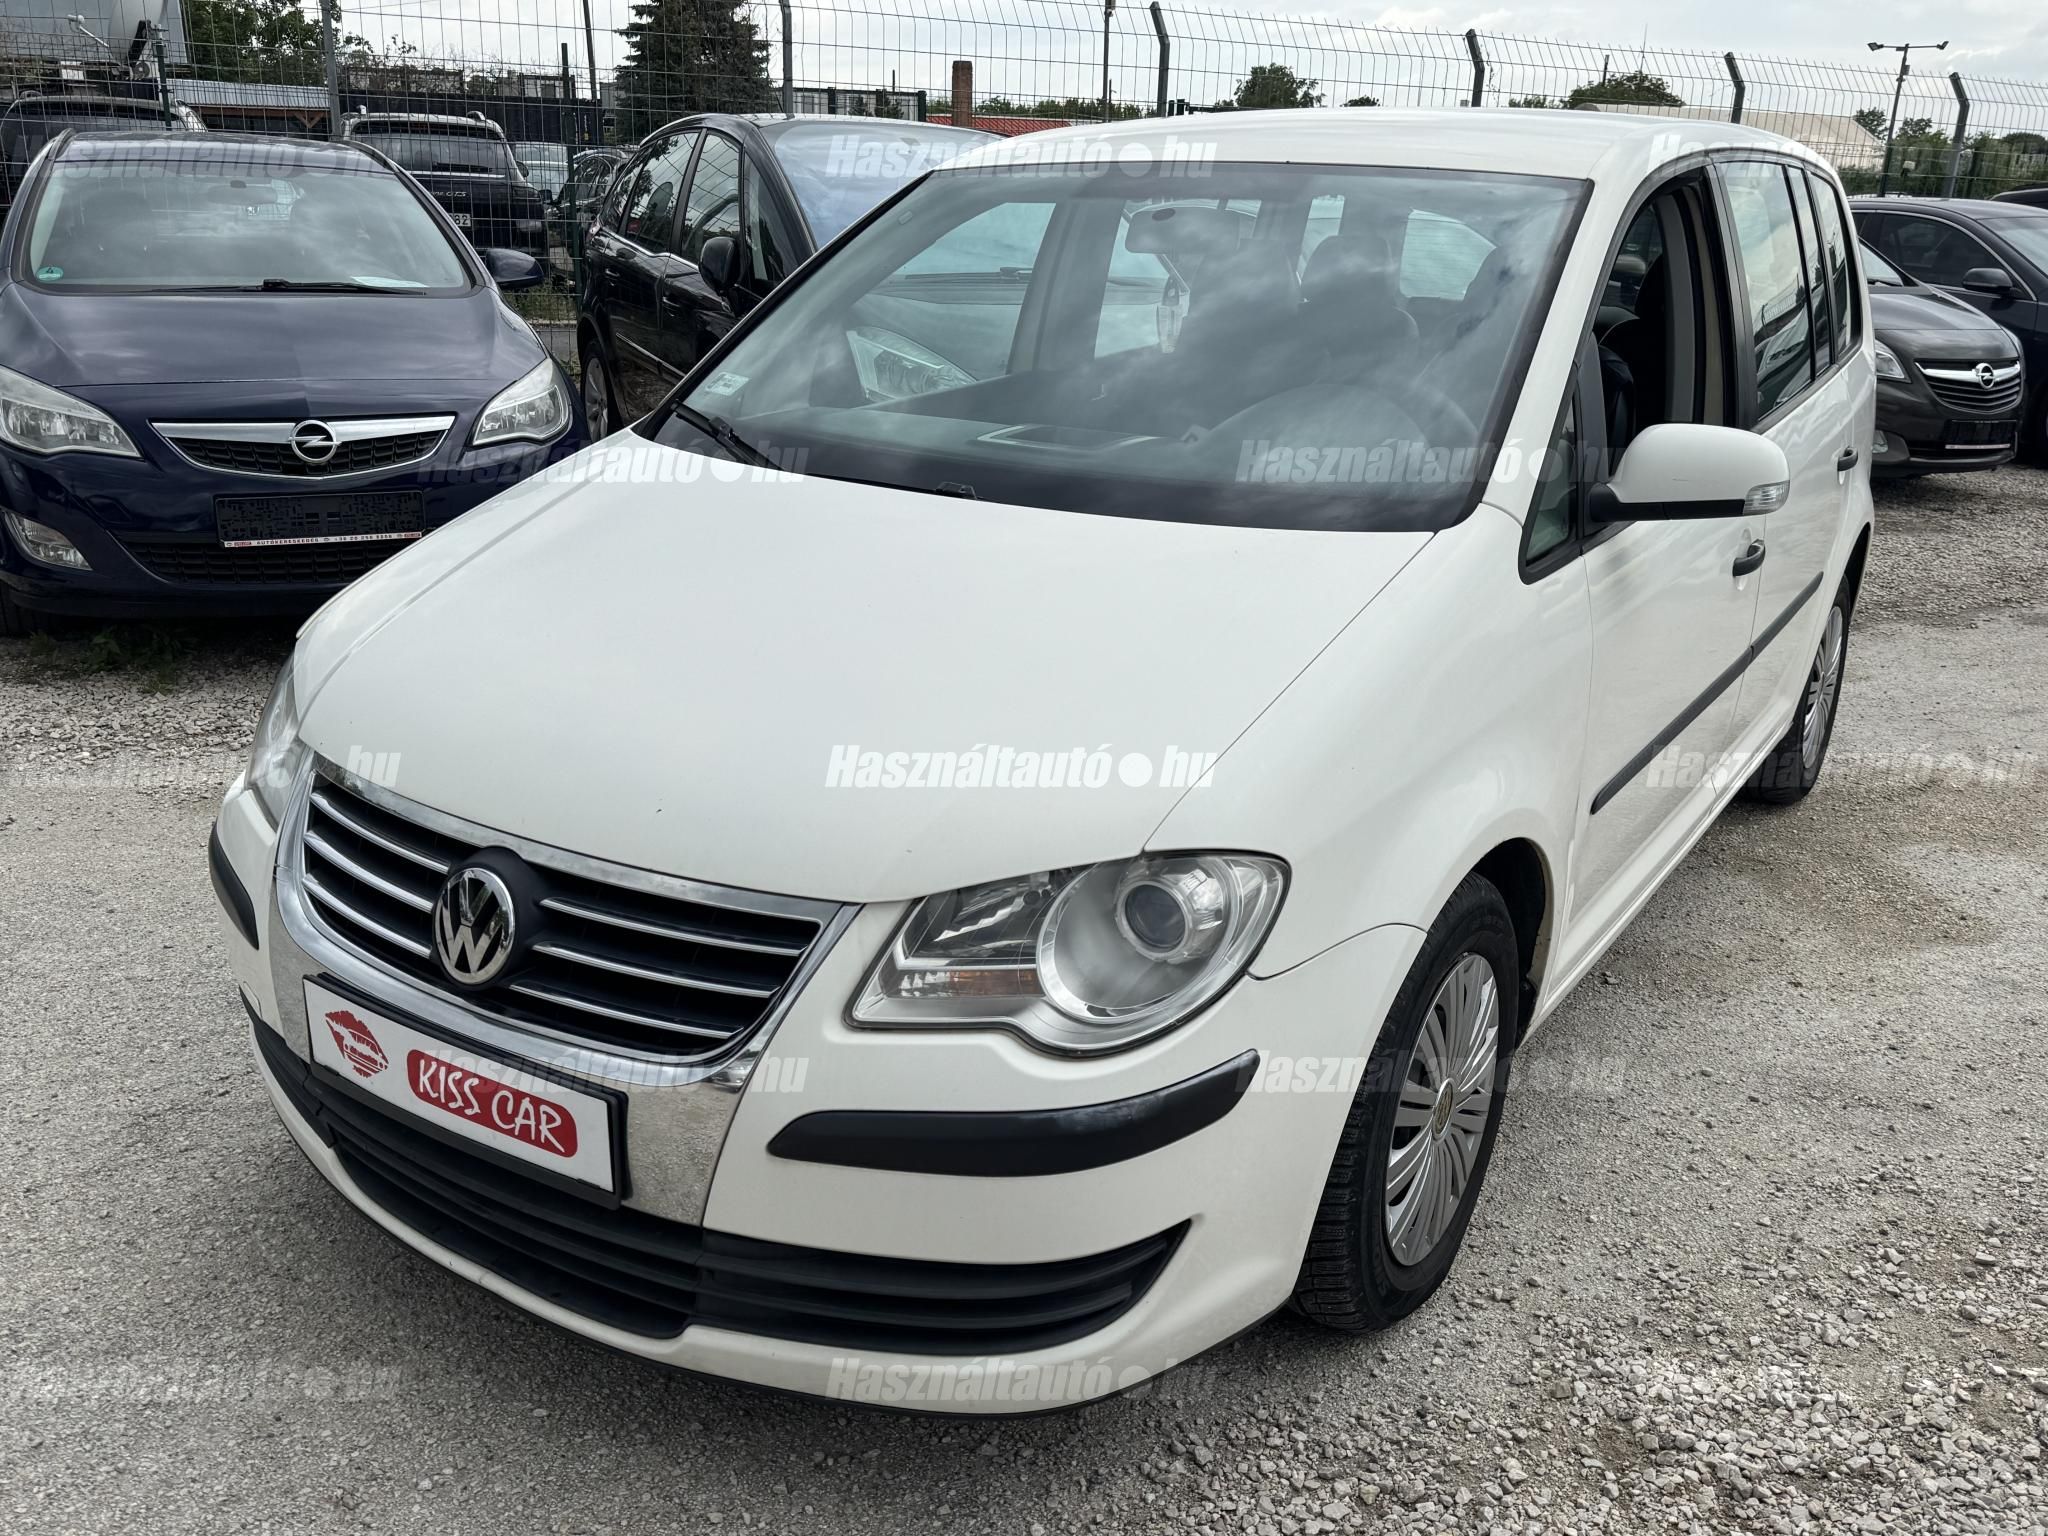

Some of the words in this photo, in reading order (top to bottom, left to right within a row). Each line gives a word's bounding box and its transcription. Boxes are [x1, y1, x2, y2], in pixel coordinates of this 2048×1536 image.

[449, 213, 469, 226] 82
[418, 1059, 481, 1116] KISS
[491, 1090, 566, 1153] CAR
